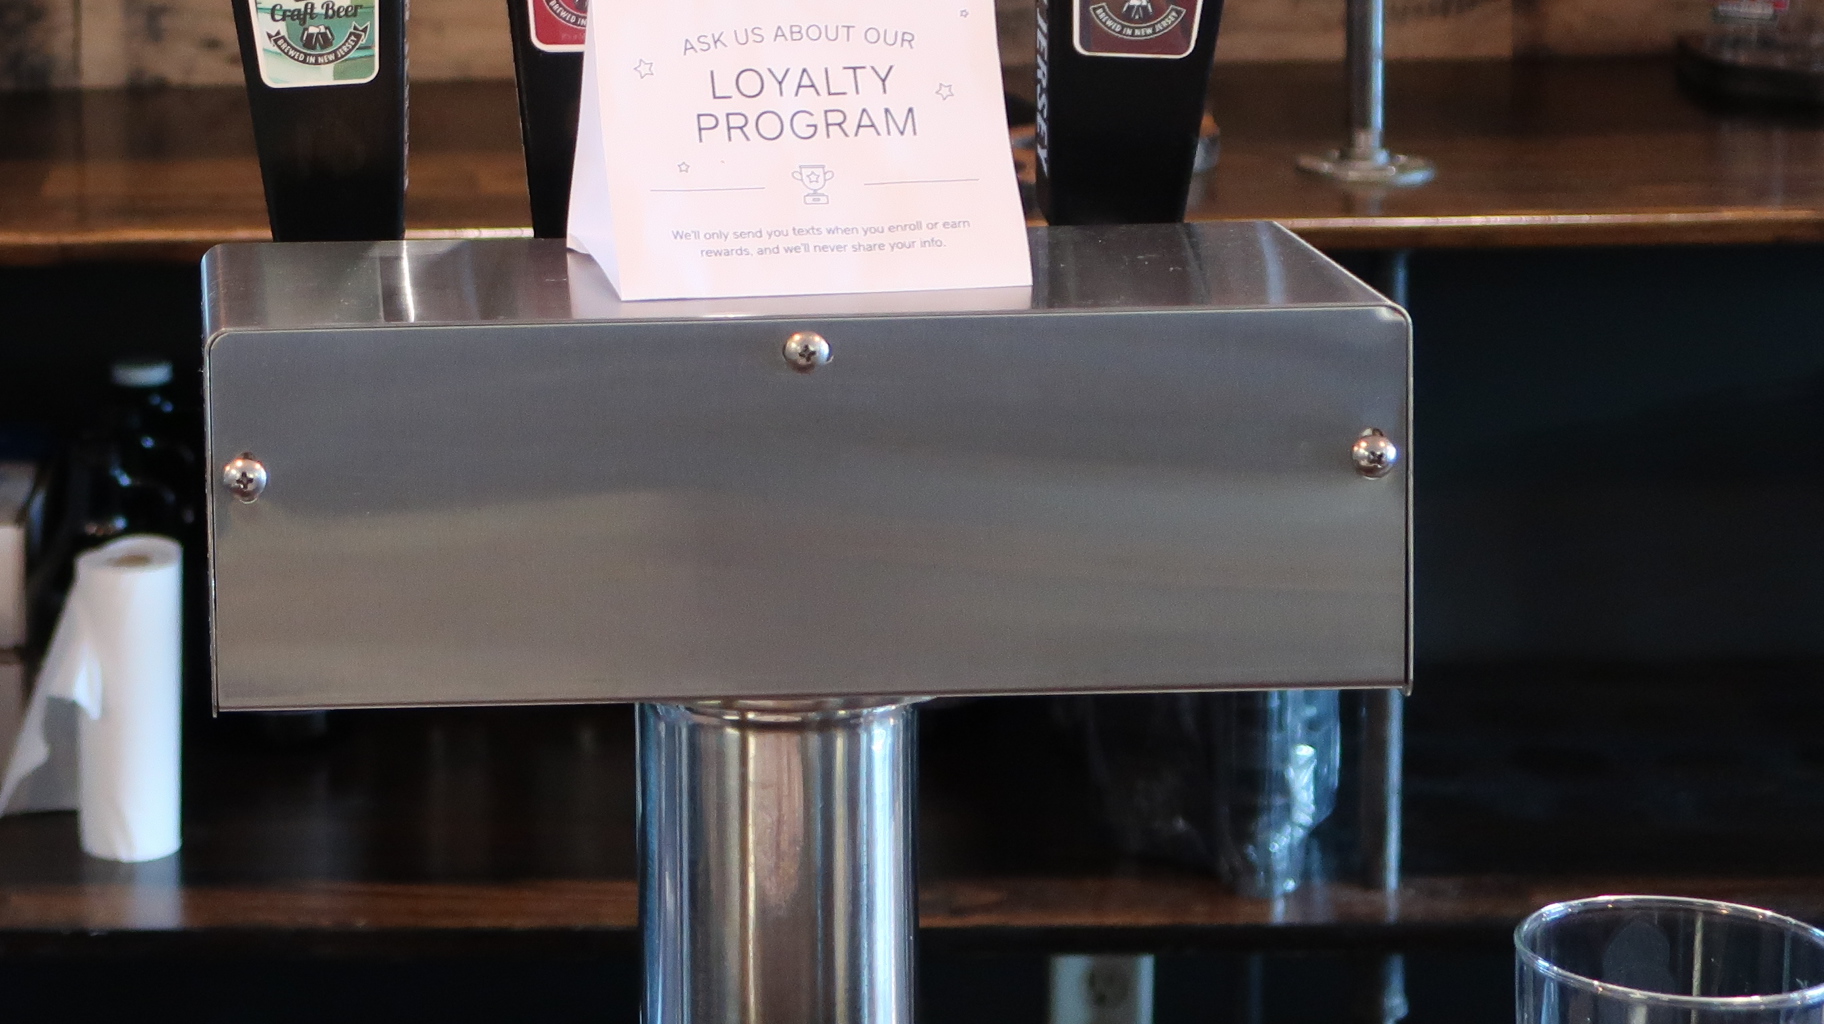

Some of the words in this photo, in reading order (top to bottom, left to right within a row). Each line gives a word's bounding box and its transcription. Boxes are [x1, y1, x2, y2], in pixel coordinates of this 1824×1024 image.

[271, 2, 316, 26] Craft
[321, 1, 363, 19] Beer
[277, 38, 304, 61] BREWED
[306, 55, 316, 63] IN
[318, 54, 335, 63] NEW
[337, 36, 358, 58] JERSEY
[682, 30, 727, 56] ASK
[733, 26, 765, 46] US
[773, 23, 856, 43] ABOUT
[863, 26, 916, 49] OUR
[709, 65, 895, 100] LOYALTY
[696, 106, 917, 143] PROGRAM
[672, 230, 700, 241] We'll
[703, 229, 729, 242] only
[733, 227, 762, 239] send
[766, 227, 789, 239] you
[792, 225, 823, 236] texts
[825, 224, 859, 236] when
[861, 224, 884, 236] you
[888, 221, 923, 234] enroll
[926, 221, 939, 230] or
[942, 218, 971, 229] earn
[700, 245, 754, 258] rewards,
[757, 243, 780, 255] and
[783, 242, 810, 254] we'll
[814, 243, 847, 253] never
[851, 240, 886, 252] share
[888, 239, 917, 252] your
[919, 236, 947, 249] info.
